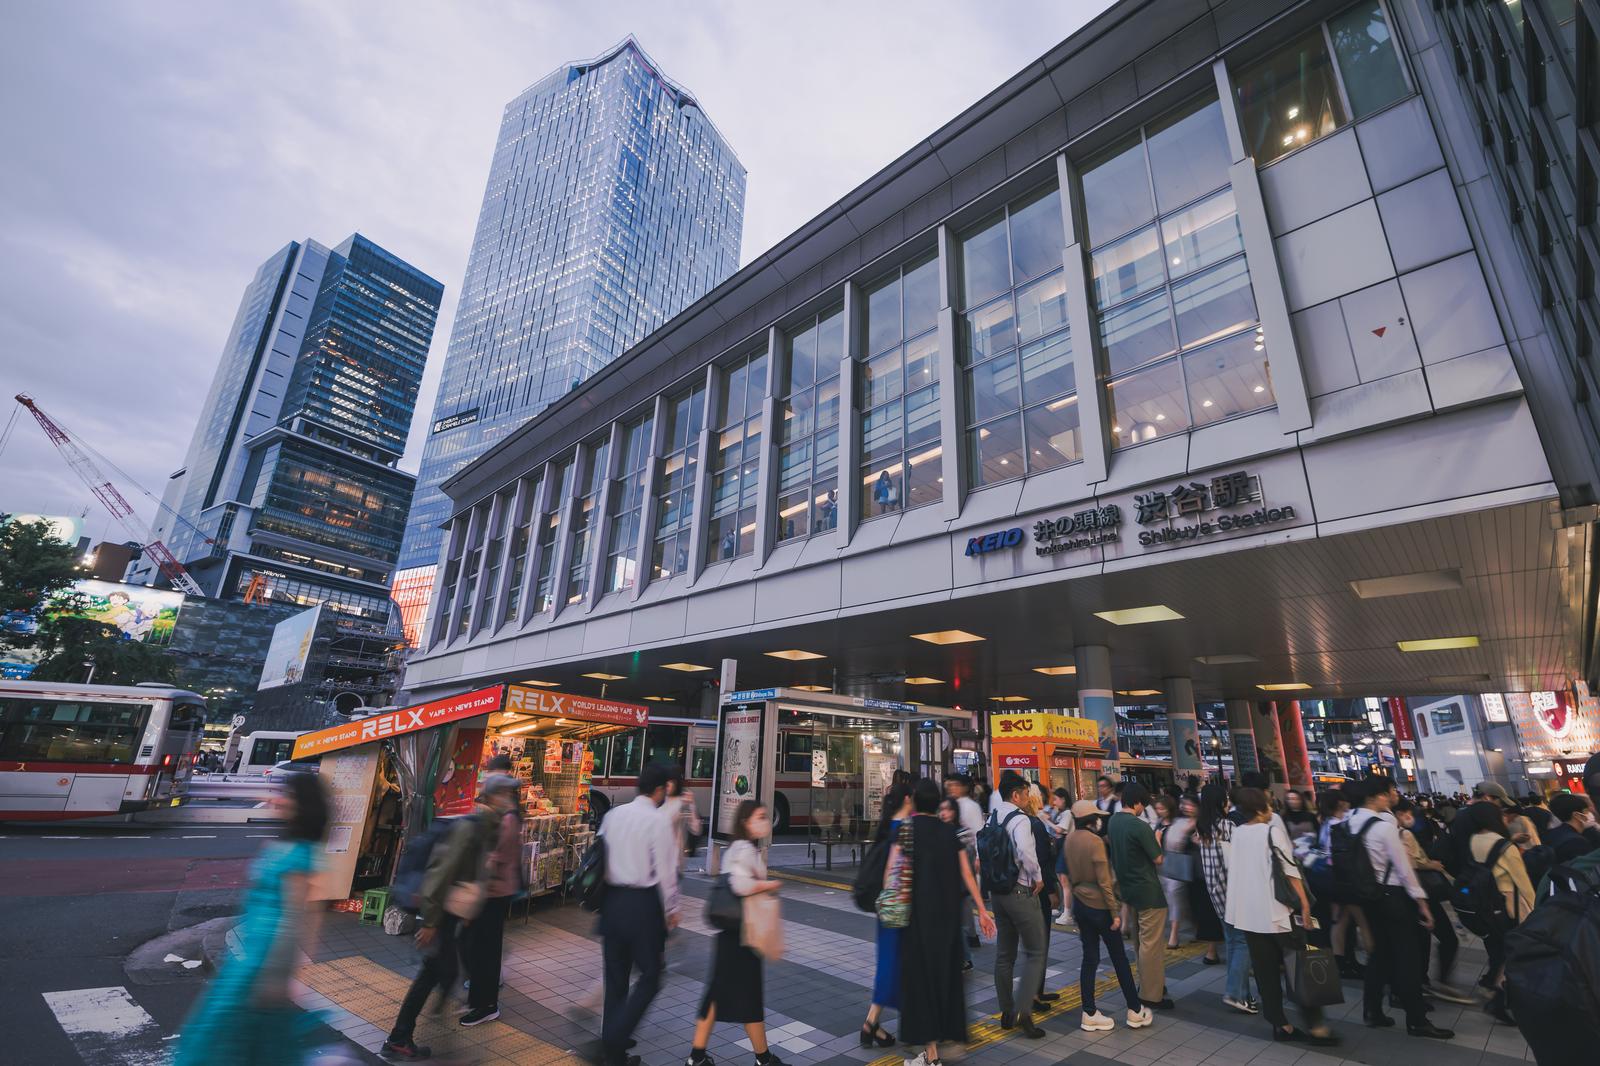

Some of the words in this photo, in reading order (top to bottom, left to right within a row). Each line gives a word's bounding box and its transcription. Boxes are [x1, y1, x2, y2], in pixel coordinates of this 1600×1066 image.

[1133, 471, 1248, 524] 渋谷駅
[1032, 503, 1121, 542] 井の頭線
[1138, 522, 1211, 546] Shibuya
[1217, 505, 1296, 531] Station
[964, 527, 1024, 557] KEIO
[508, 688, 566, 714] RELX
[572, 699, 596, 710] WORLD'S
[596, 703, 619, 713] LEADING
[620, 706, 633, 715] VAPE
[300, 740, 314, 750] VAPE
[322, 735, 338, 745] NEWS
[339, 730, 357, 741] STAND
[361, 708, 425, 740] RELX
[428, 708, 446, 719] VAPE
[455, 701, 473, 712] NEWS
[473, 696, 495, 708] STAND
[1000, 718, 1034, 733] 宝くじ
[1013, 757, 1030, 765] 宝くじ
